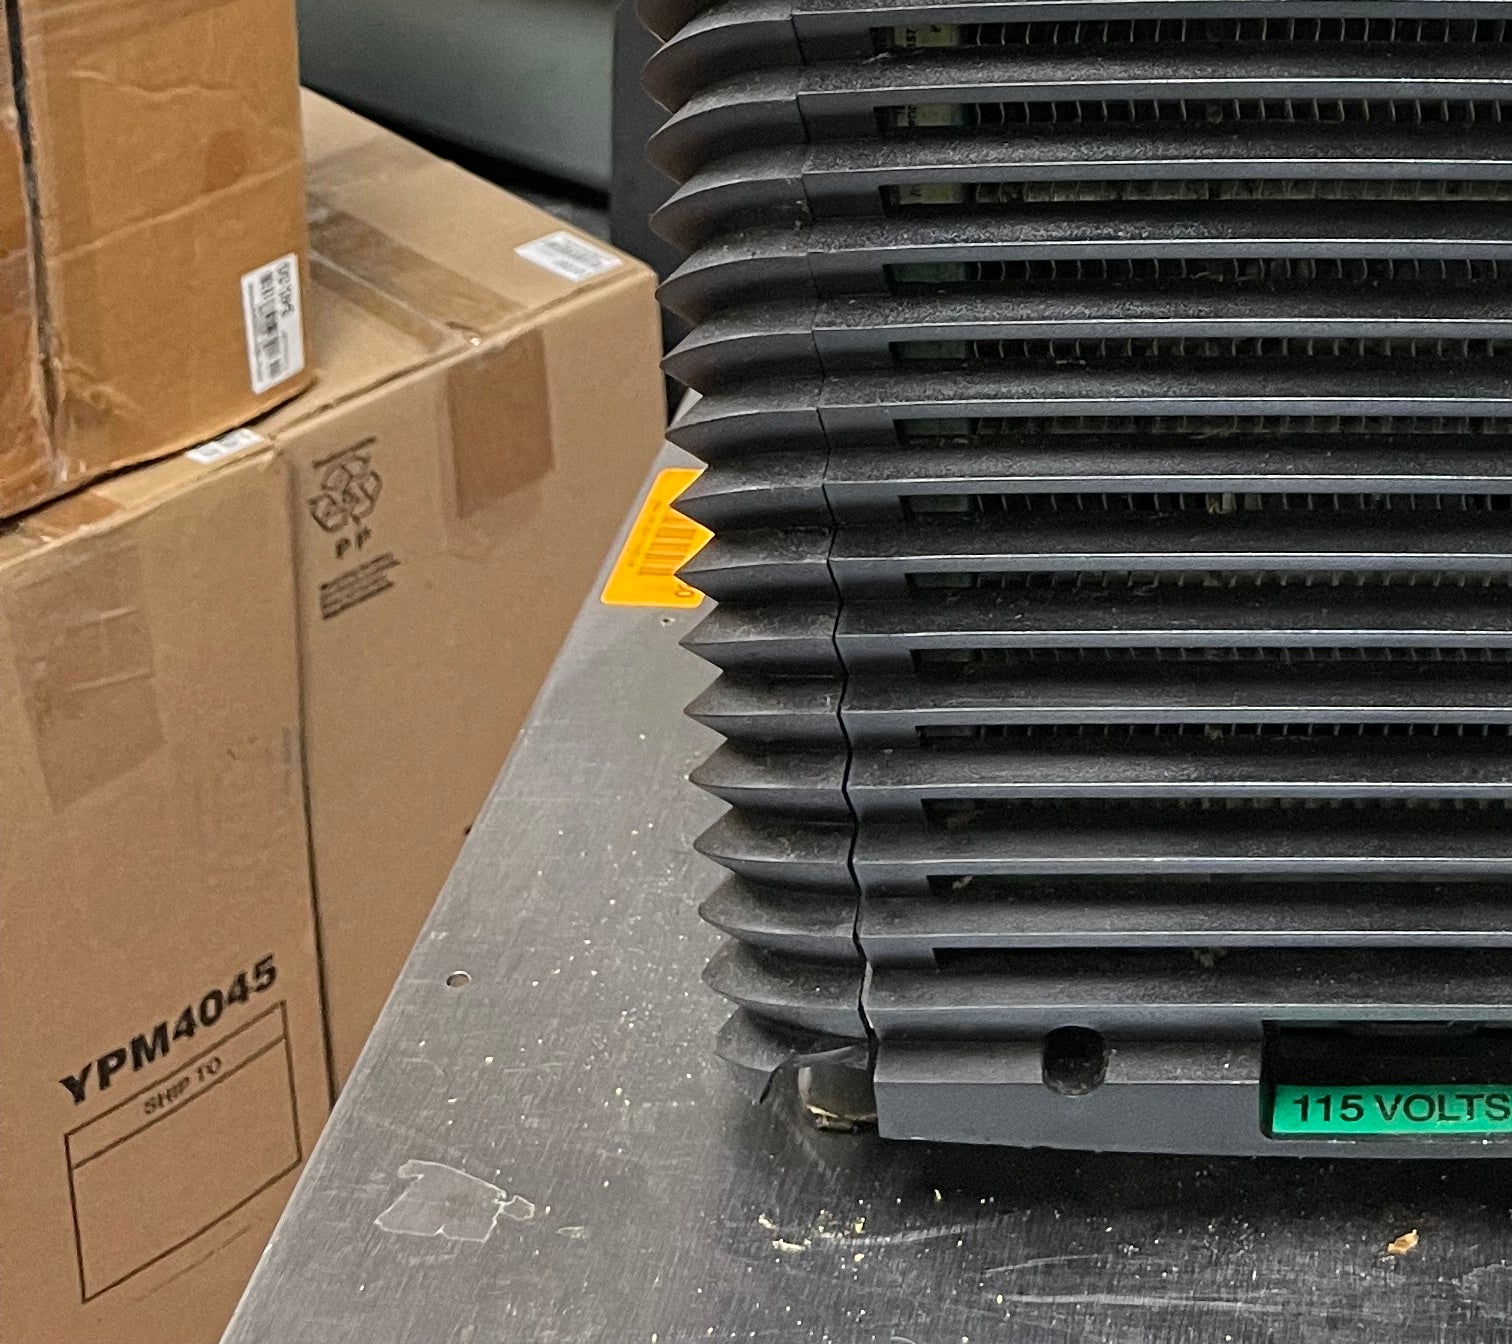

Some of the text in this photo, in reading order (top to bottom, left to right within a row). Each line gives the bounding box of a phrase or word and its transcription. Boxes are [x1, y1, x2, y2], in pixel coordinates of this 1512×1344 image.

[59, 952, 278, 1105] YPM4045
[143, 1076, 190, 1115] SHIP
[1293, 1092, 1512, 1123] 115 VOLTS
